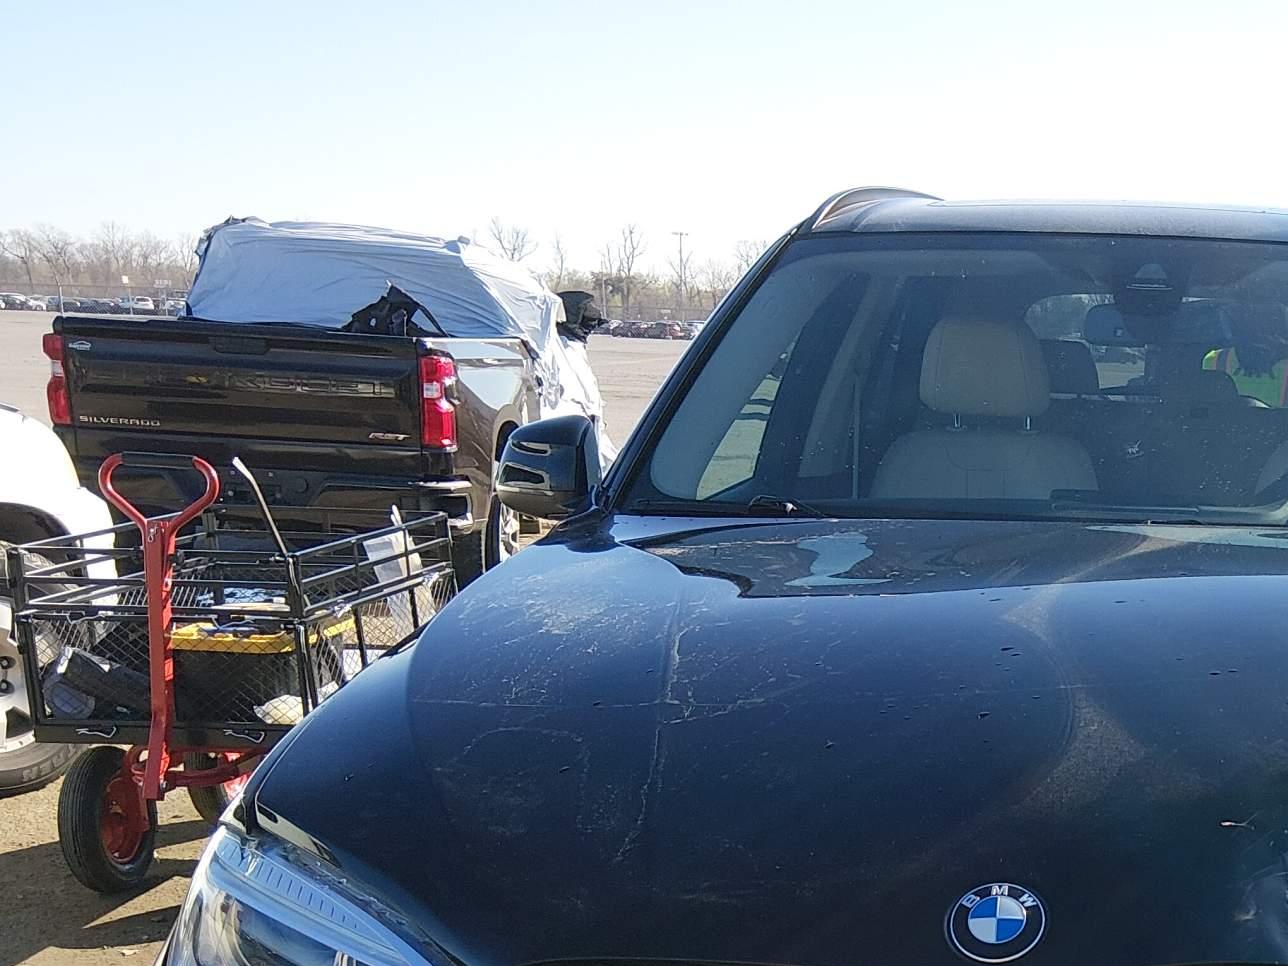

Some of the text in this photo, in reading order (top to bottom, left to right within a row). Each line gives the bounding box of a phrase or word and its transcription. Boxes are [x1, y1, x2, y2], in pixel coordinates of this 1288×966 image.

[79, 415, 161, 427] SILVERADO
[368, 432, 411, 441] RST
[961, 885, 1038, 908] BMW
